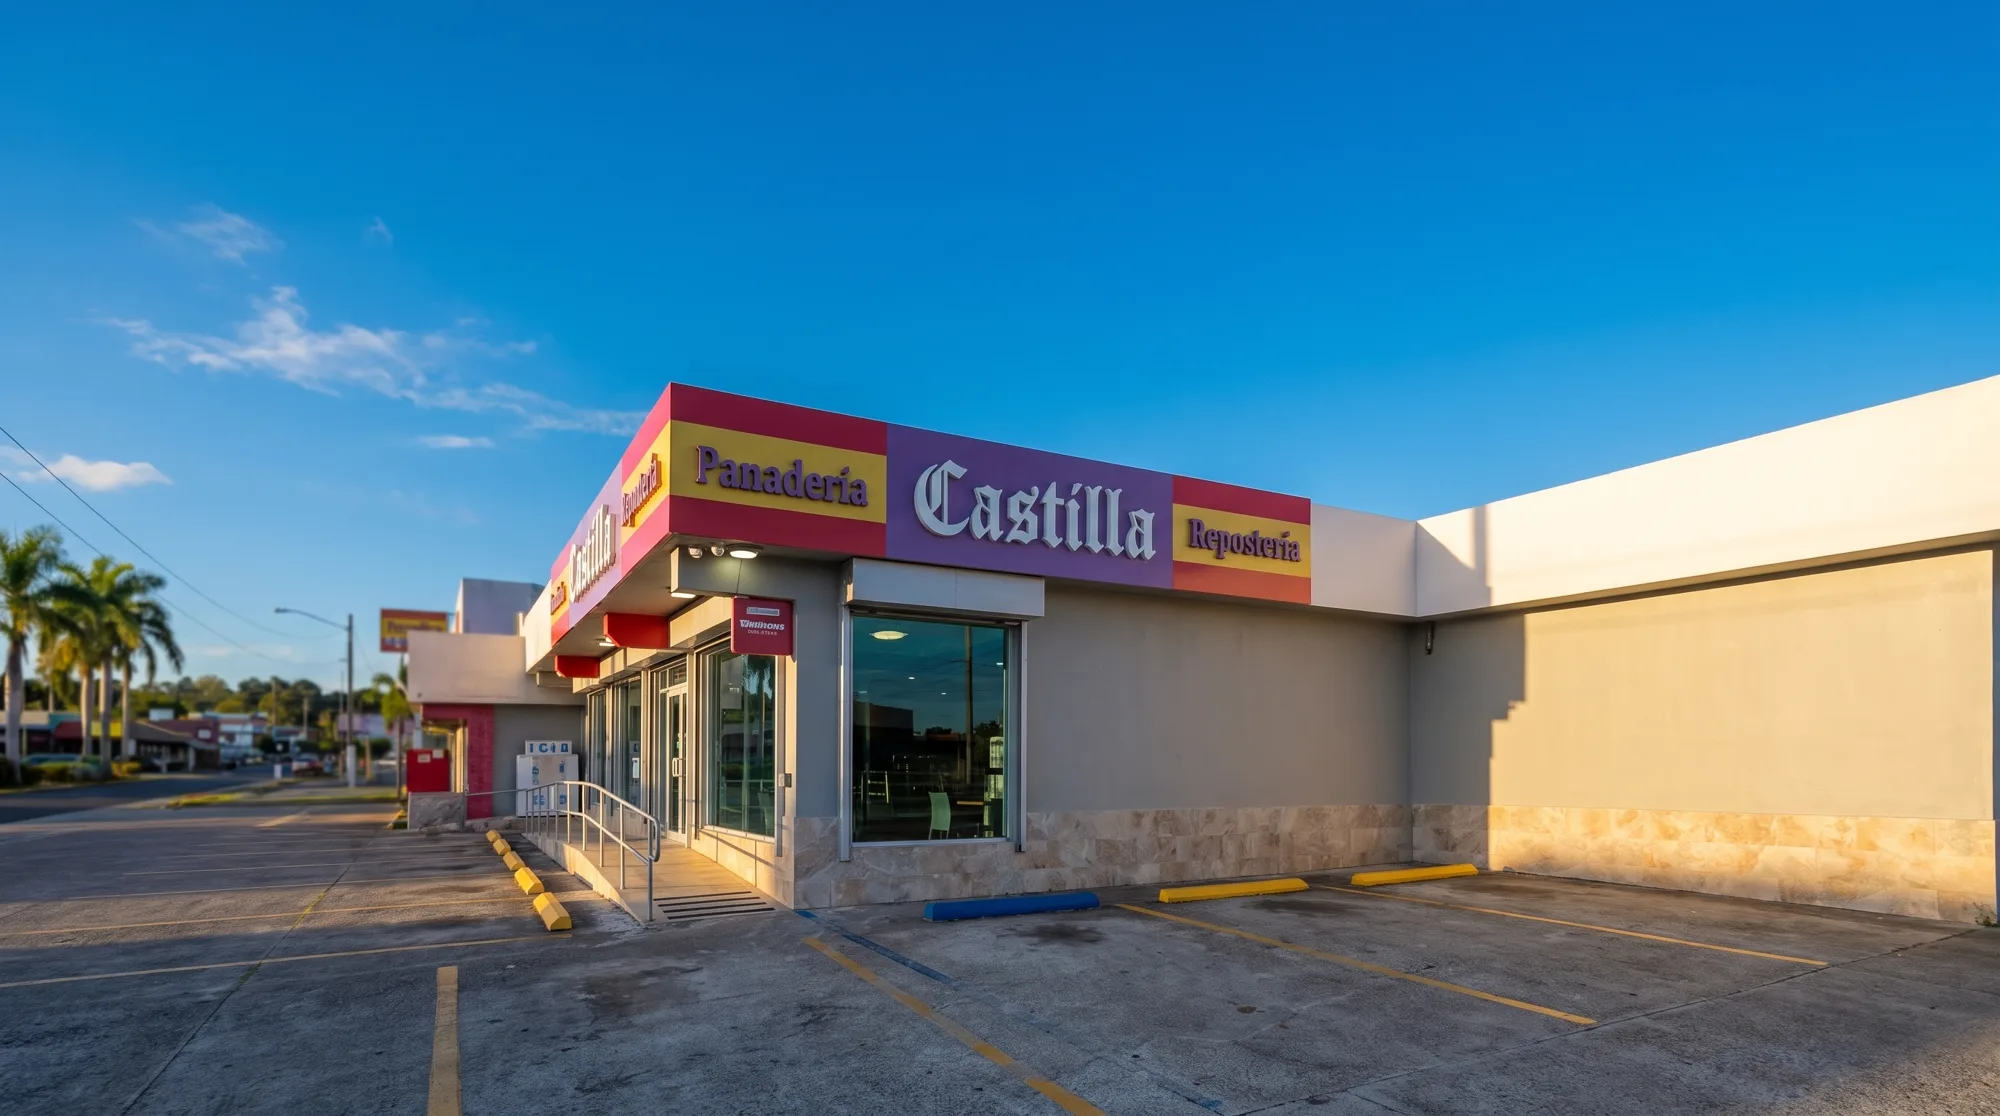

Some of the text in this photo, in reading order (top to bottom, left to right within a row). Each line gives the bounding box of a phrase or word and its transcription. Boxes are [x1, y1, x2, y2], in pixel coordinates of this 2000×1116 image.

[695, 445, 869, 506] Panadería
[913, 459, 1157, 561] Castilla
[1187, 518, 1301, 562] Repostería
